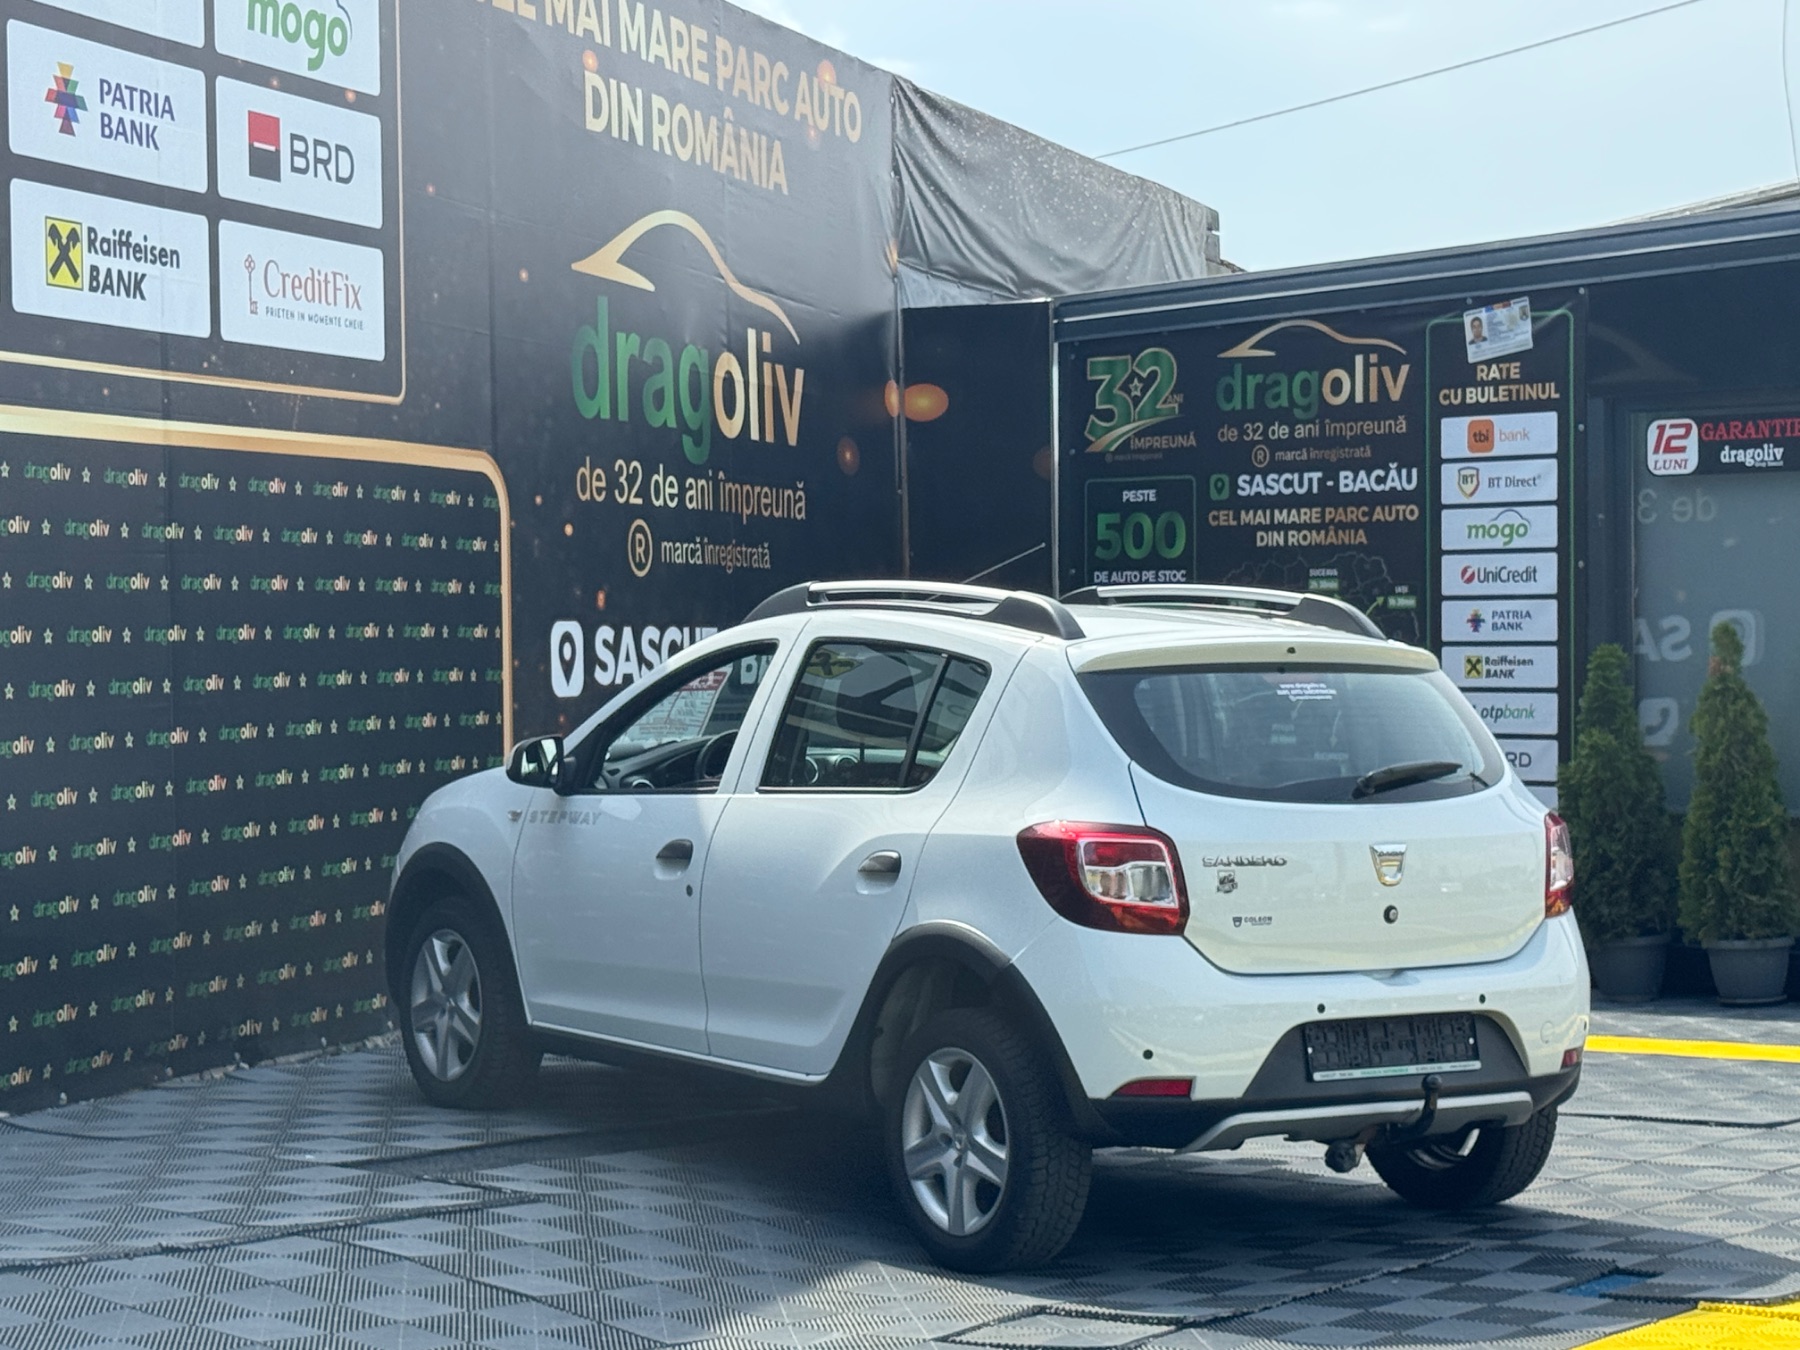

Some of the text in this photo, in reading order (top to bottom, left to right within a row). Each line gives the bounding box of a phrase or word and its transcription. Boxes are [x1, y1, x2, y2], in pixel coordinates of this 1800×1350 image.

[247, 0, 349, 71] mogo
[545, 0, 862, 143] MAI MARE PARC AUTO
[99, 78, 175, 122] PATRIA
[100, 112, 160, 151] BANK
[584, 70, 789, 195] DIN ROMÂNIA
[289, 133, 354, 185] BRD
[87, 226, 180, 270] Raiffeisen
[88, 265, 147, 301] BANK
[263, 260, 363, 312] CreditFix
[572, 296, 804, 464] dragoliv
[1216, 354, 1410, 420] dragoliv
[1476, 362, 1521, 381] RATE
[1439, 382, 1560, 406] CU BULETINUL
[1217, 415, 1407, 442] de 32 de ani împreună
[1472, 430, 1489, 443] tbi
[1499, 427, 1530, 442] bank
[1652, 422, 1693, 455] 12
[1275, 448, 1308, 462] marcă
[1653, 459, 1689, 471] LUNI
[1720, 443, 1784, 467] dragoliv
[24, 461, 406, 504] dragoliv dragoliv dragoliv dragoliv dragoliv dragoliv
[576, 455, 806, 525] de 32 de ani împreună
[1122, 490, 1157, 503] PESTE
[1237, 472, 1323, 497] SASCUT
[1339, 463, 1418, 493] BACĂU
[1487, 476, 1502, 489] BT
[1208, 504, 1419, 526] CEL MAI MARE PARC AUTO
[0, 515, 487, 553] goliv dragoliv dragoliv dragoliv dragoliv dragoliv dragoliv dragoliv
[1095, 511, 1187, 559] 500
[1256, 526, 1367, 547] DIN ROMÂNIA
[1467, 520, 1529, 547] mogo
[661, 538, 703, 565] marcă
[704, 539, 771, 574] înregistrată
[25, 571, 408, 595] dragoliv dragoliv dragoliv dragoliv dragoliv dragoliv
[1094, 570, 1187, 583] DE AUTO PE STOC
[1477, 565, 1538, 583] UniCredit
[1491, 610, 1532, 621] PATRIA
[1491, 620, 1524, 631] BANK
[67, 622, 488, 647] dragoliv dragoliv dragoliv dragoliv dragoliv dragoliv dragoliv
[594, 625, 719, 686] SASC
[1484, 656, 1534, 667] Raiffeisen
[28, 679, 75, 702] dragoliv
[108, 677, 152, 698] dragoliv
[183, 674, 224, 695] dragoliv
[252, 671, 291, 692] dragoliv
[317, 669, 352, 689] dragoliv
[377, 668, 410, 687] dragoliv
[432, 667, 464, 685] dragoliv
[1485, 669, 1515, 679] BANK
[1481, 702, 1535, 723] otpbank
[0, 710, 489, 759] agoliv dragoliv dragoliv dragoliv dragoliv dragoliv dragoliv dragoliv
[1505, 752, 1532, 769] RD
[31, 759, 412, 810] dragoliv dragoliv dragoliv dragoliv dragoliv dragoliv
[71, 837, 117, 860] dragoliv
[149, 829, 191, 852] dragoliv
[221, 821, 261, 842] dragoliv
[288, 814, 324, 835] dragoliv
[349, 808, 384, 827] dragoliv
[529, 810, 601, 825] STEPWAY
[33, 895, 79, 919] dragoliv
[113, 885, 157, 908] dragoliv
[188, 875, 230, 897] dragoliv
[257, 866, 295, 887] dragoliv
[321, 857, 357, 878] dragoliv
[71, 900, 386, 967] dragoliv dragoliv dragoliv dragoliv dragoliv
[32, 952, 358, 1028] dragoliv dragoliv dragoliv dragoliv dragoliv
